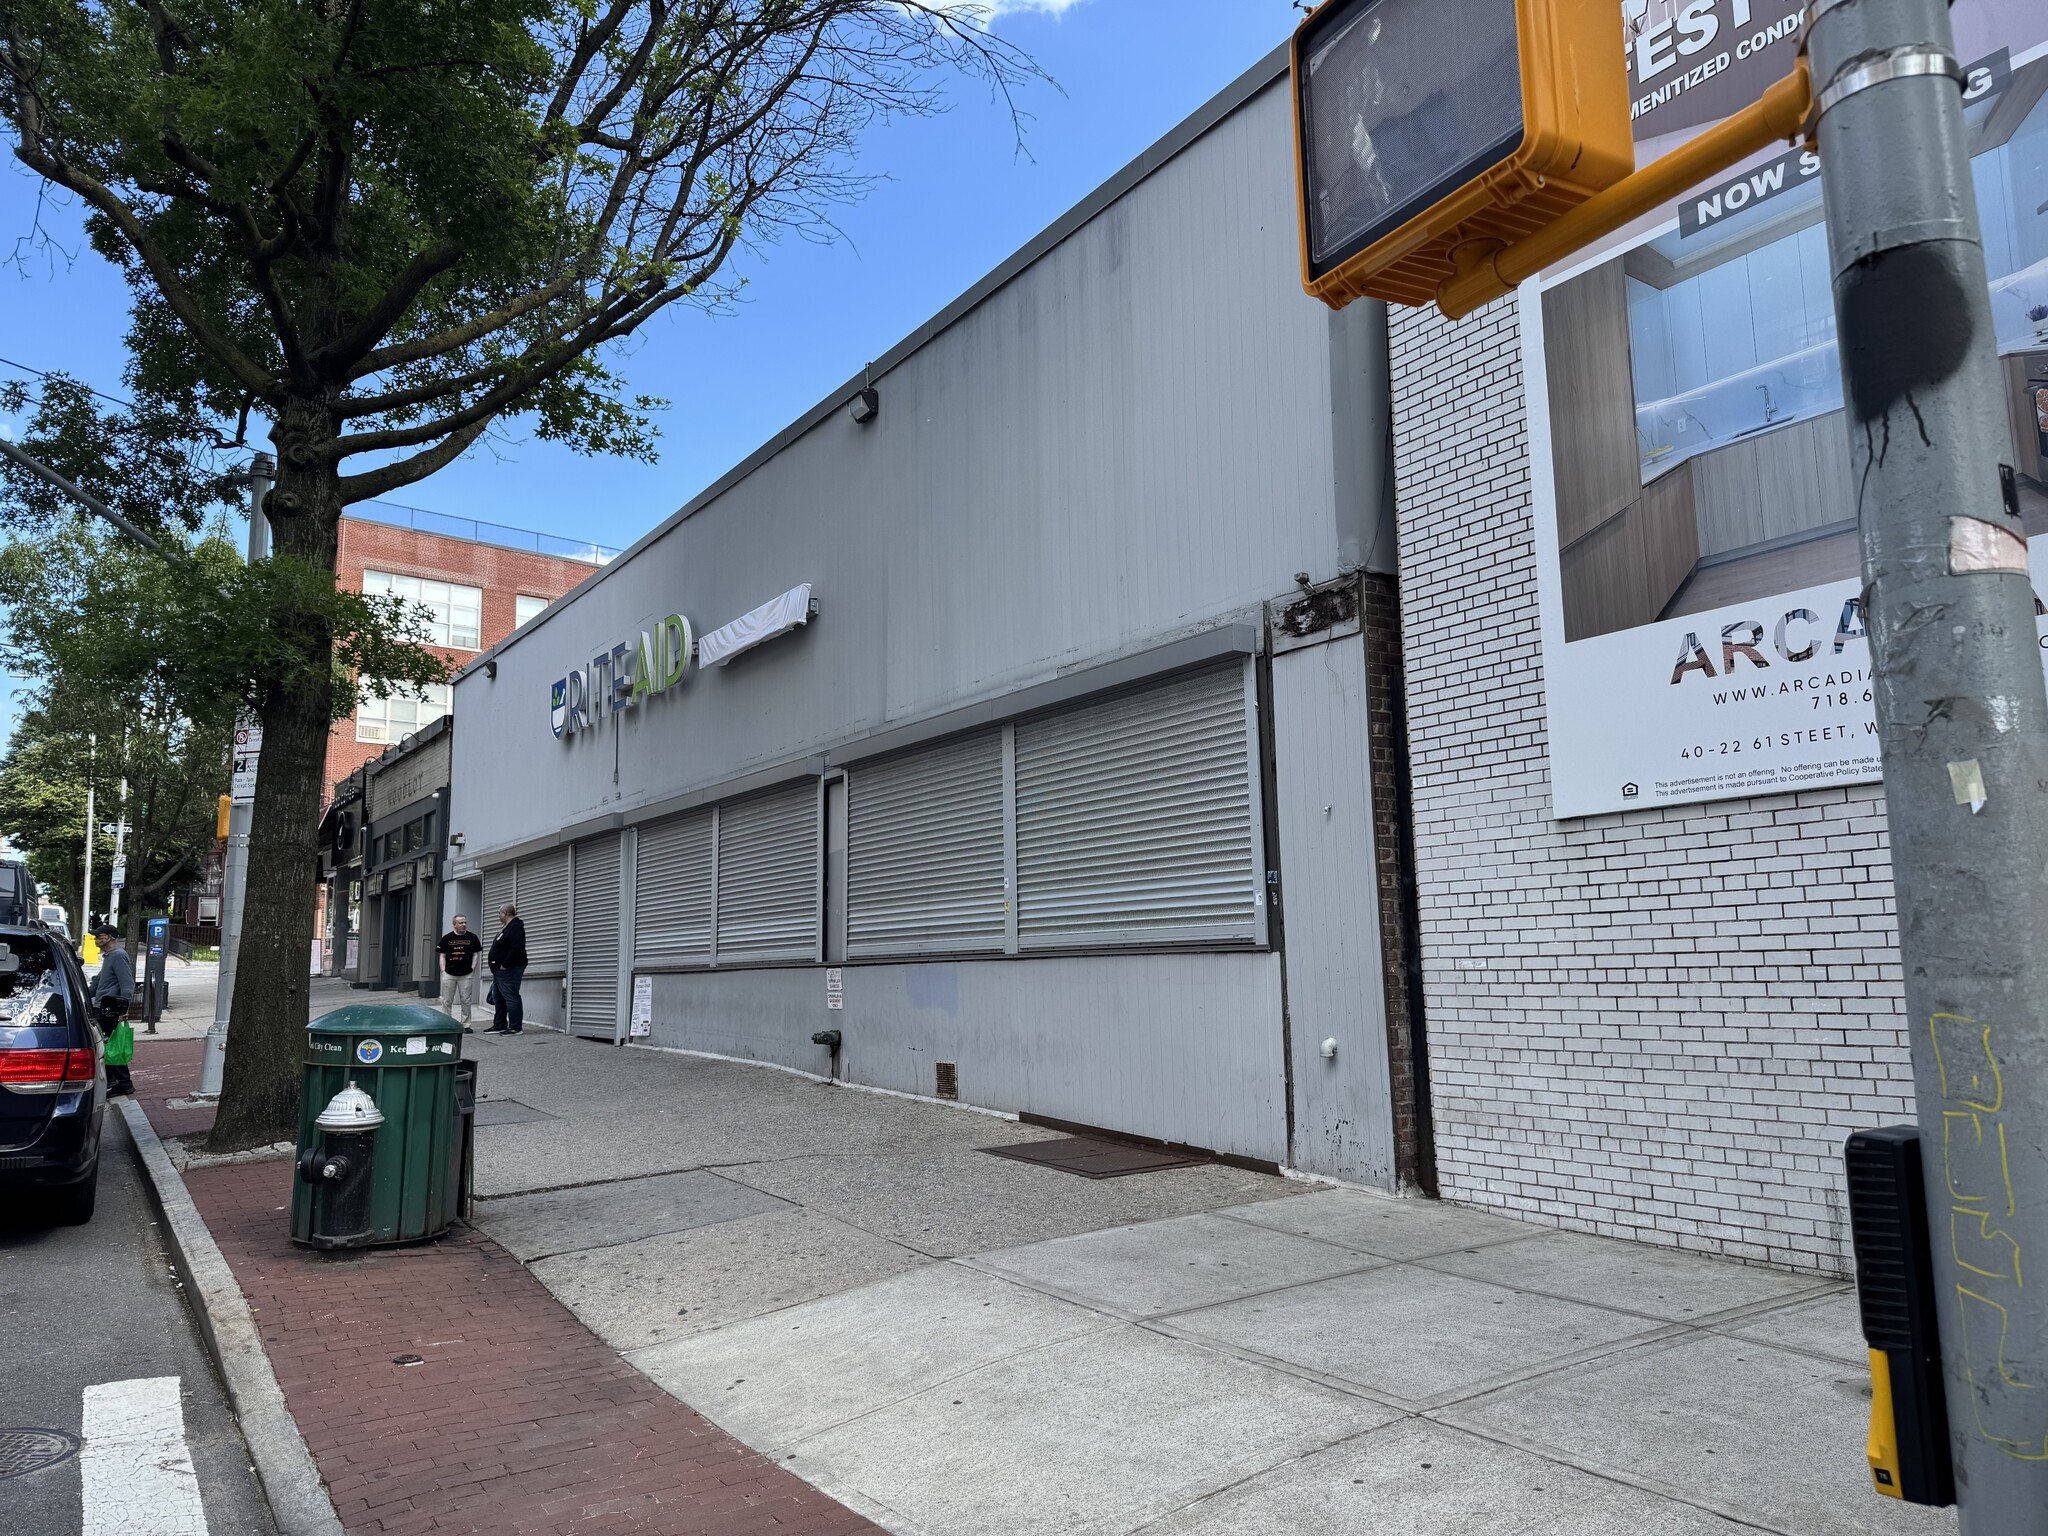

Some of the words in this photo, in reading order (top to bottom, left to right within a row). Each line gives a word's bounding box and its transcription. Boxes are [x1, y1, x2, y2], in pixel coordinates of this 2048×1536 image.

[1697, 162, 1785, 225] NOW
[569, 641, 633, 733] RITE
[632, 613, 693, 703] AID
[1681, 740, 1741, 759] 40-22
[1753, 736, 1772, 750] 61
[236, 760, 244, 772] 2
[1655, 781, 1668, 789] This
[1670, 775, 1716, 787] advertisement
[1725, 772, 1736, 780] not
[1781, 765, 1792, 773] No
[1794, 762, 1822, 772] offering
[1840, 758, 1850, 766] be
[1852, 756, 1874, 765] made
[1655, 790, 1669, 798] This
[1670, 783, 1717, 796] advertisement
[1726, 780, 1745, 788] made
[1746, 775, 1779, 787] pursuant
[1789, 770, 1835, 782] Cooperative
[1836, 766, 1859, 776] Policy
[324, 1042, 342, 1052] Clean
